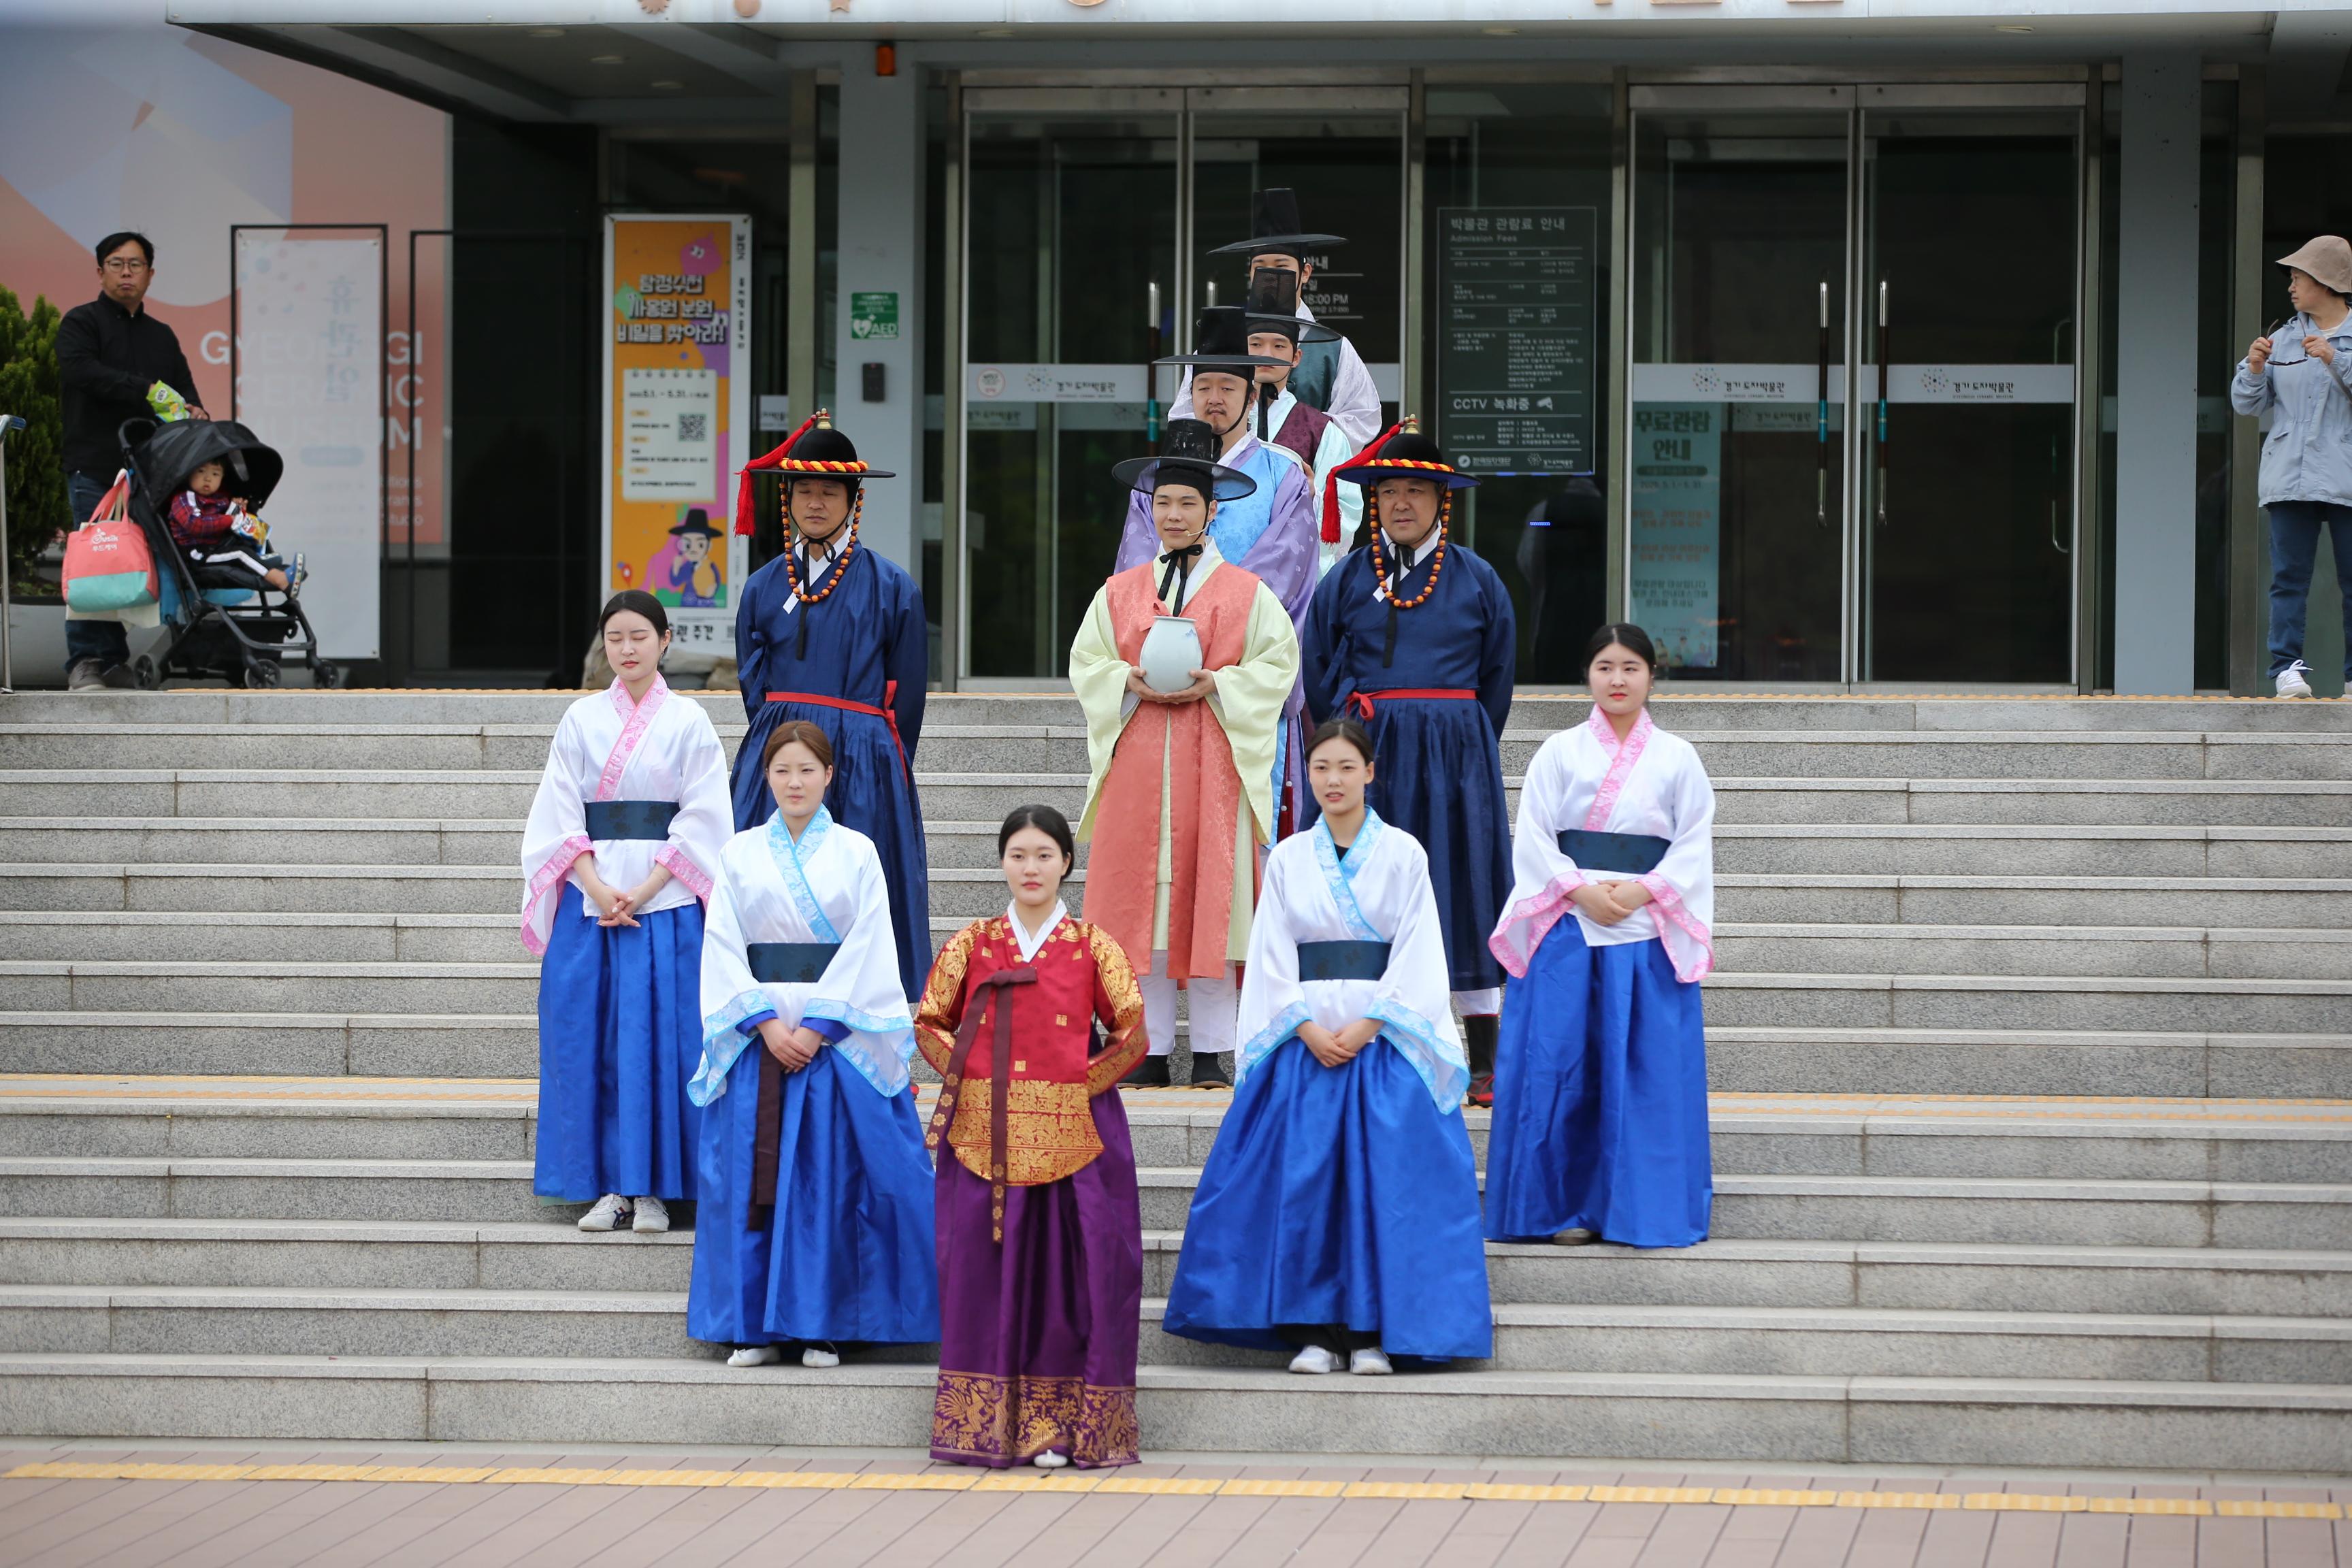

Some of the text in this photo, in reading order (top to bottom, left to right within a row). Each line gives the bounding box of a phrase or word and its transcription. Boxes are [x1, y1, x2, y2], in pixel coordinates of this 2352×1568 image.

[1450, 217, 1565, 231] 박물관 관람료 안내
[1497, 234, 1517, 242] Fees
[1333, 293, 1349, 304] PM
[618, 323, 726, 344] 비밀을 찾아라!
[871, 323, 897, 333] AED
[1057, 381, 1116, 393] 경기 도자박물관
[1725, 381, 1785, 393] 경기 도자박물관
[1953, 382, 2014, 393] 경기 도자박물관
[1453, 397, 1529, 411] CCTV 녹화중
[1635, 410, 1711, 433] 무료관람
[1653, 439, 1690, 461] 안내
[693, 624, 714, 641] 주간
